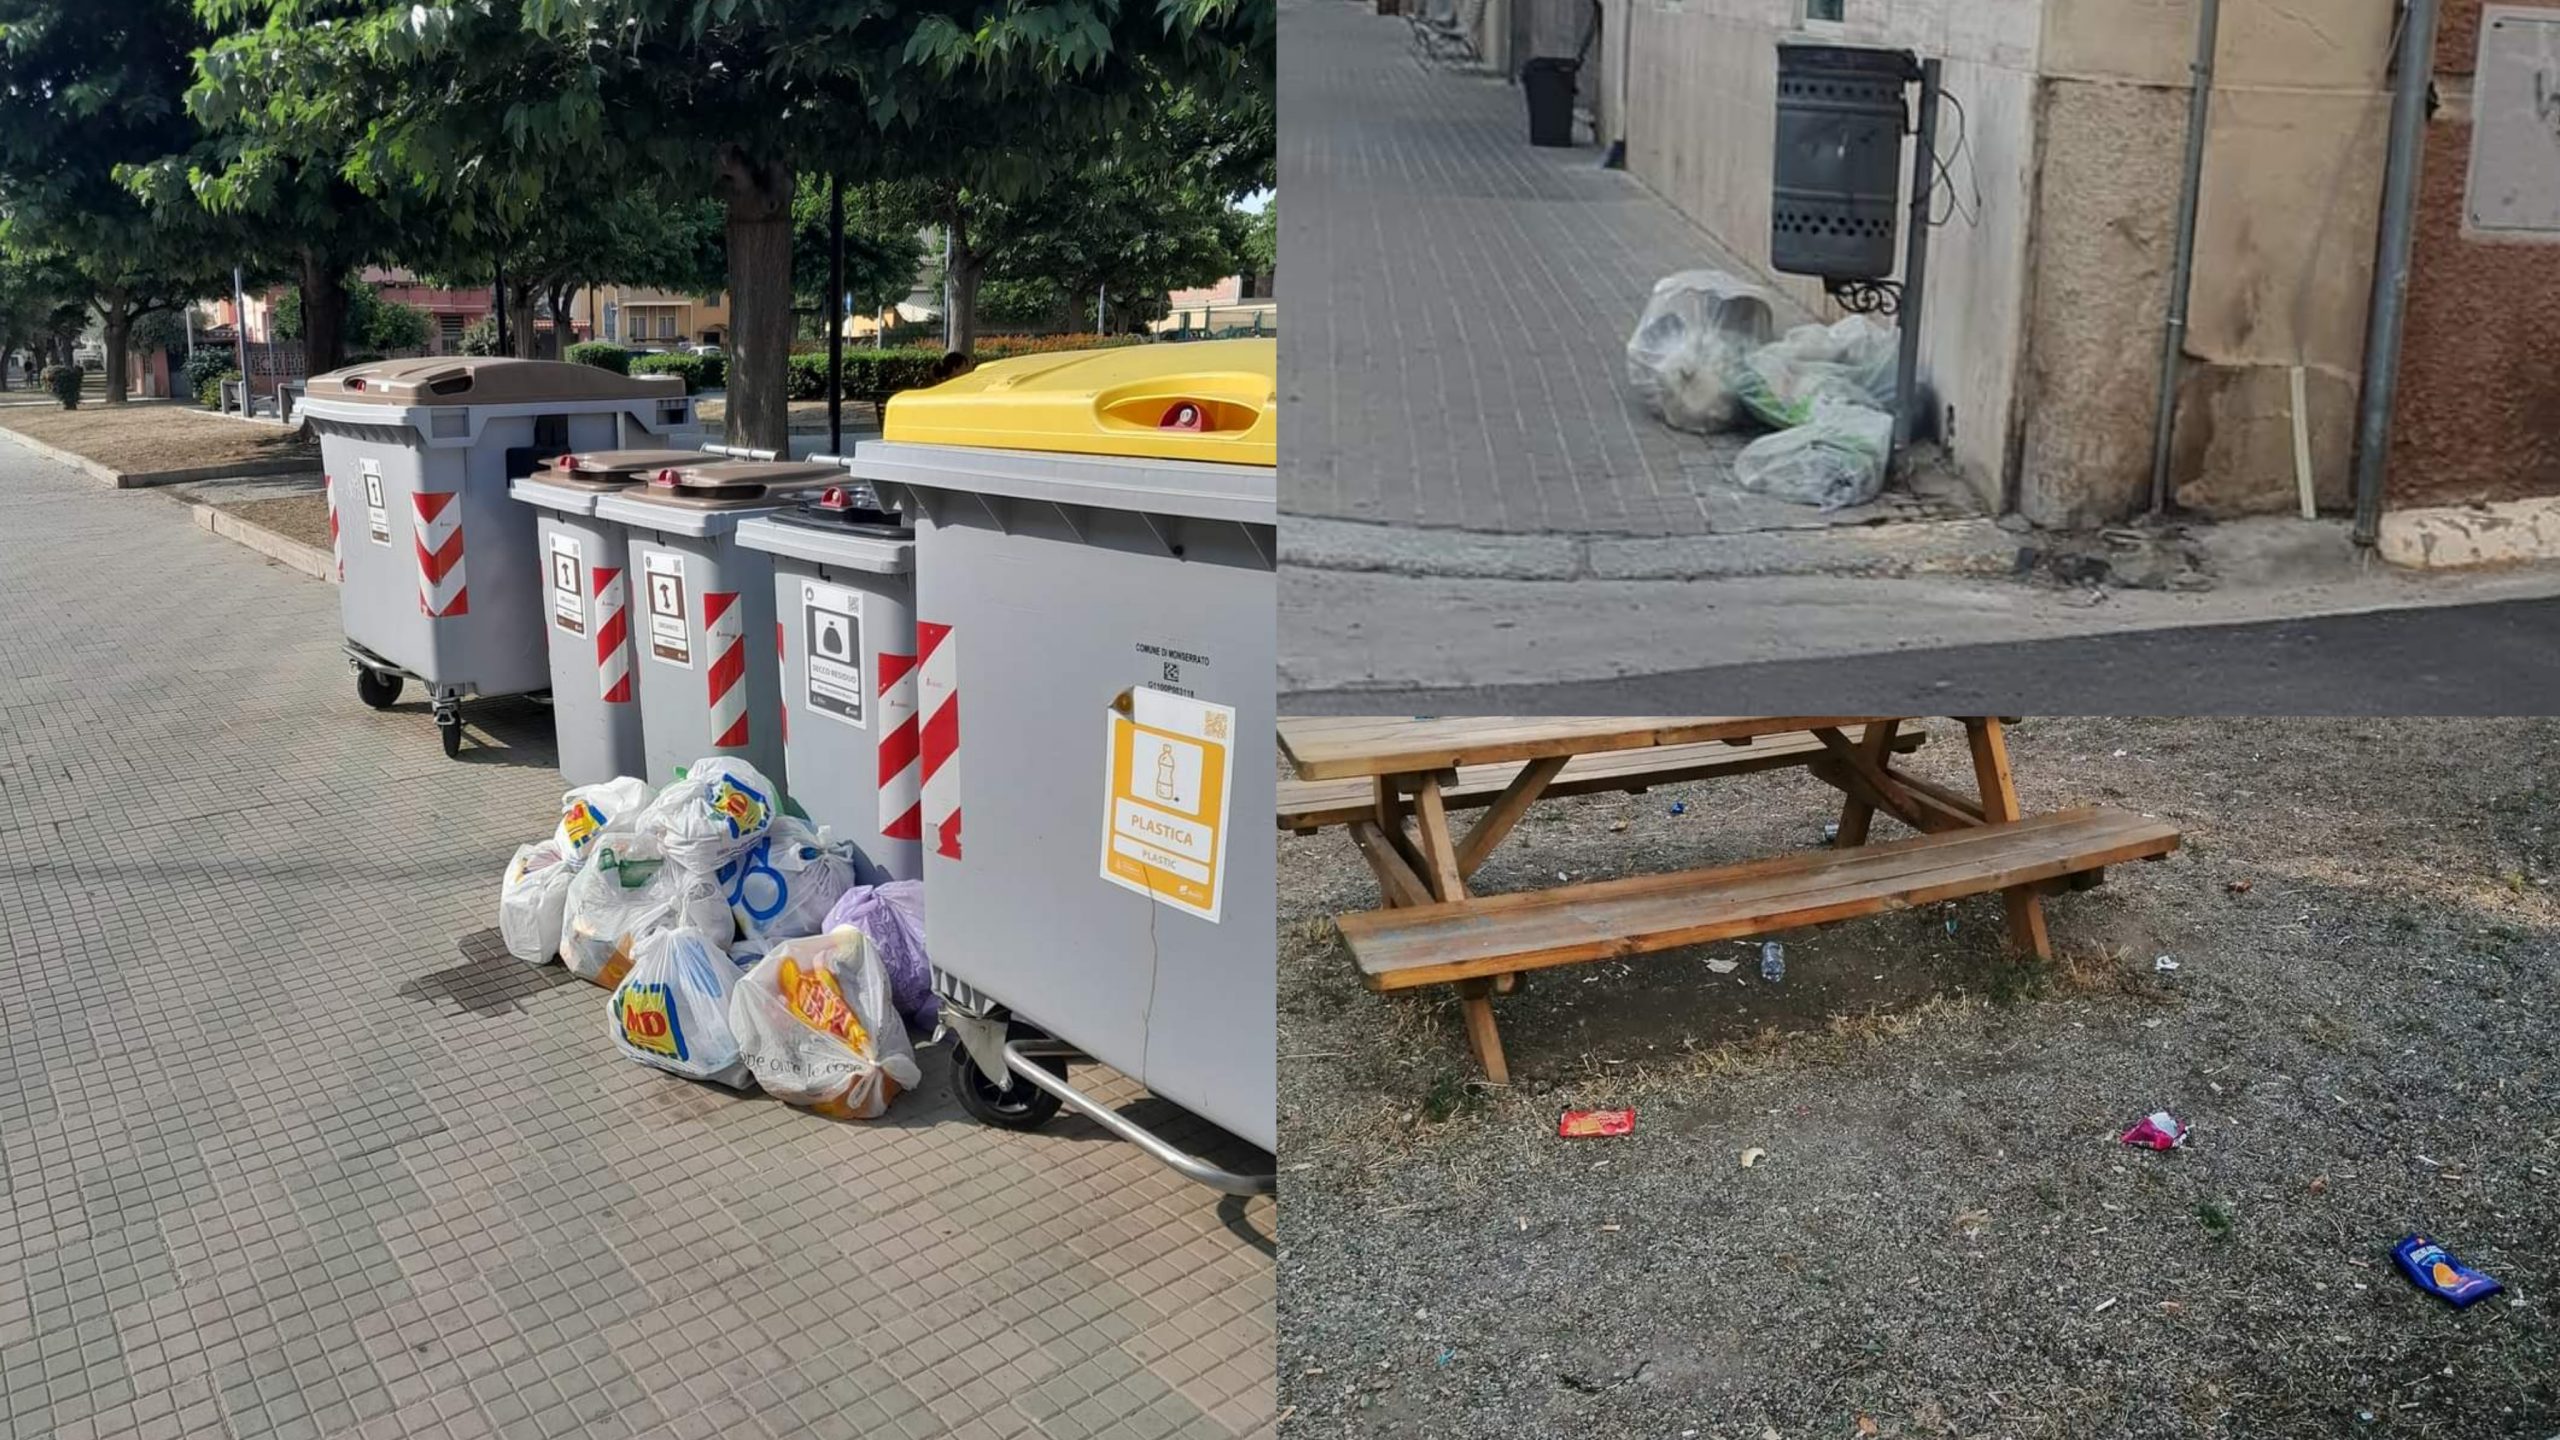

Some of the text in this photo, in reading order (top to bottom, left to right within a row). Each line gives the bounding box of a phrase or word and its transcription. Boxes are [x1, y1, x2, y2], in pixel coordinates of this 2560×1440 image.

[1135, 643, 1160, 656] COMUNE
[1168, 650, 1210, 666] MONSERRATO
[1131, 814, 1193, 846] PLASTICA
[1142, 849, 1177, 870] PLASTIC
[626, 1004, 667, 1037] MD
